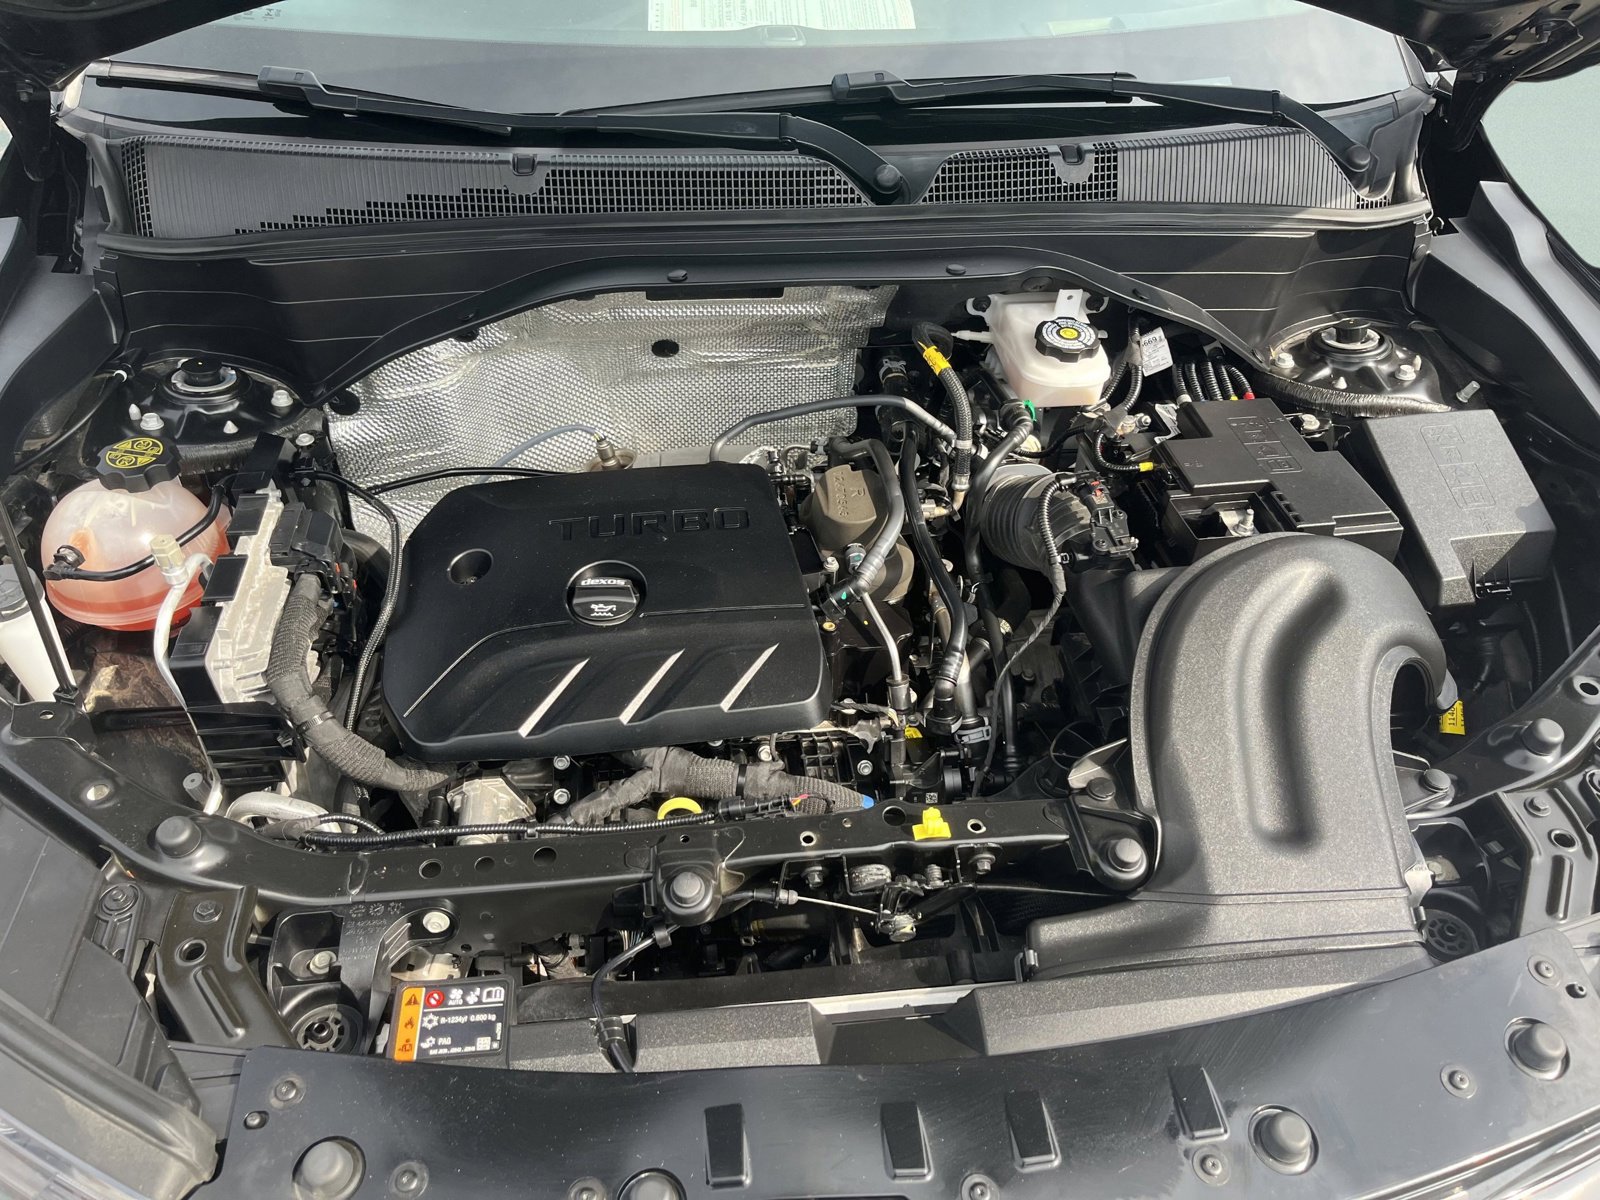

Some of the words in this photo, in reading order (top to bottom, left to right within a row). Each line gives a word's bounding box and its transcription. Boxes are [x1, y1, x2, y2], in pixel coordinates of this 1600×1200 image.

[549, 507, 750, 541] TURBO
[581, 578, 626, 586] dexos
[487, 1013, 497, 1021] kg
